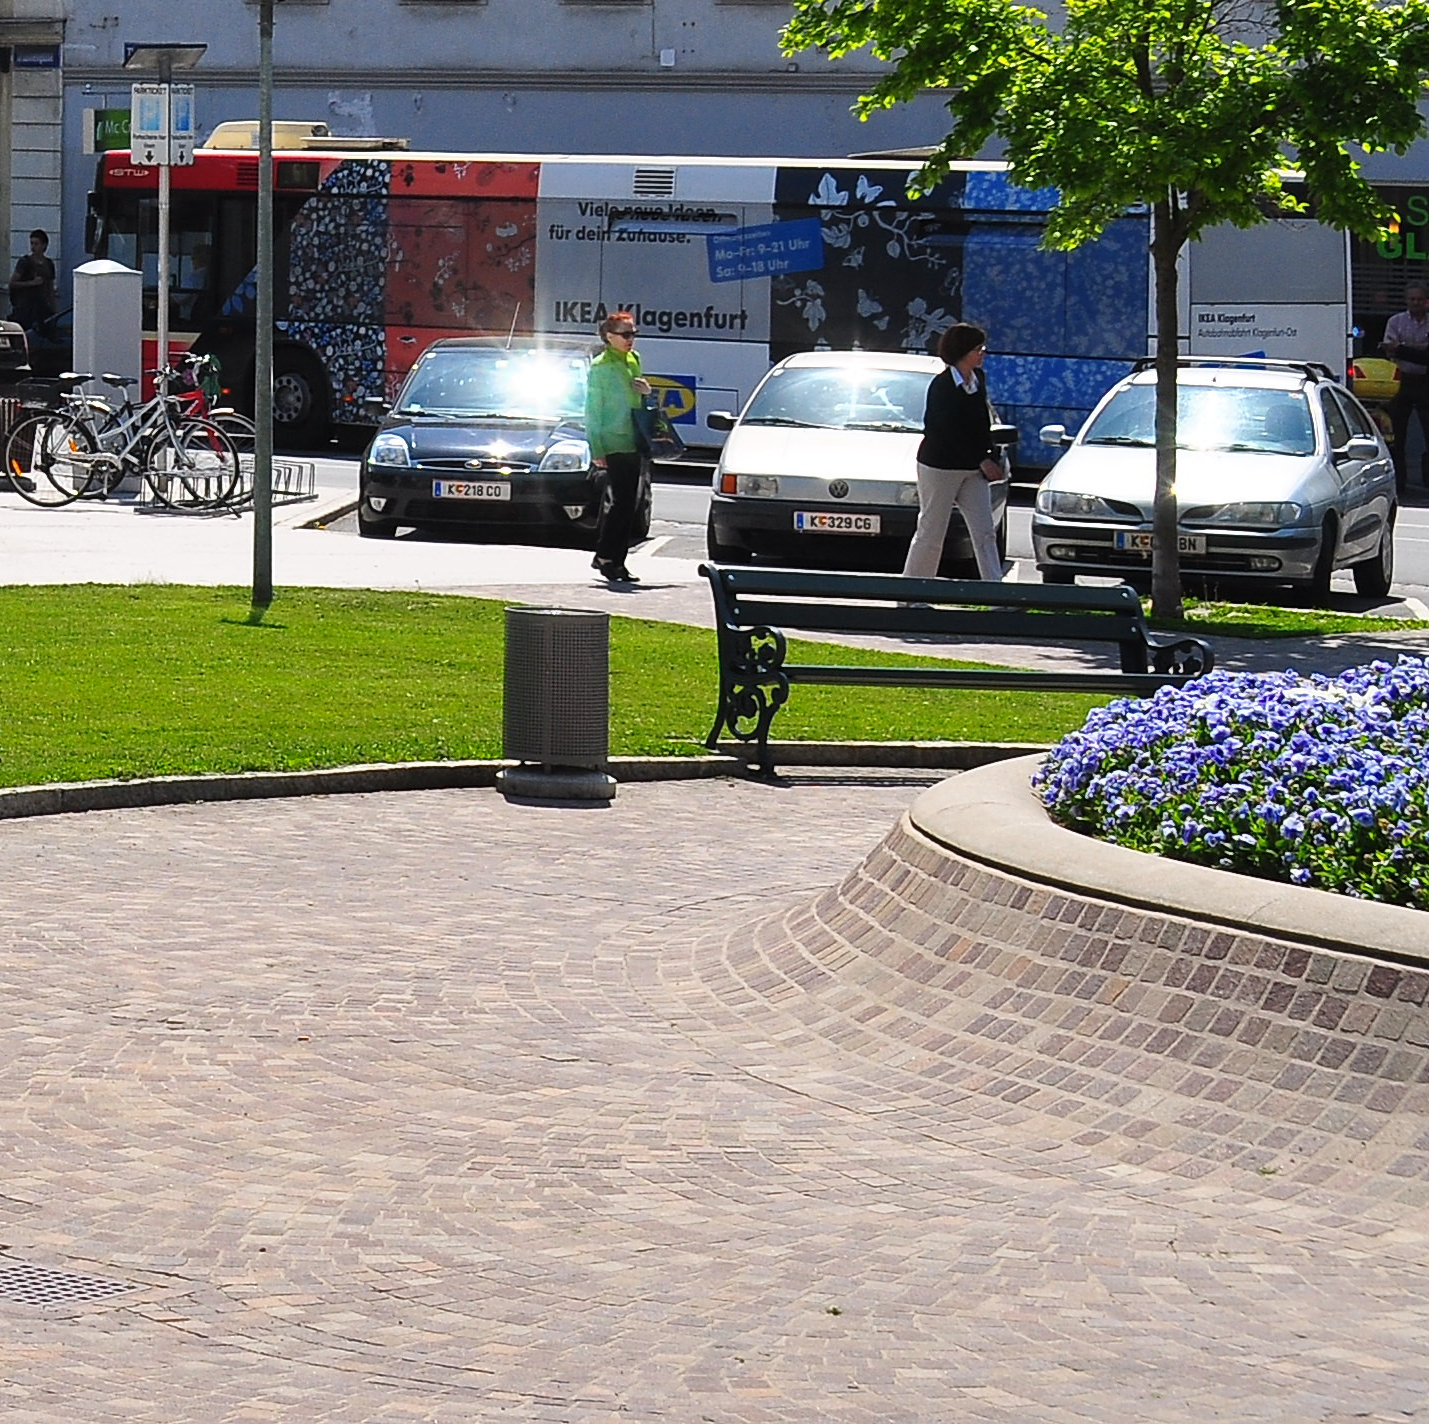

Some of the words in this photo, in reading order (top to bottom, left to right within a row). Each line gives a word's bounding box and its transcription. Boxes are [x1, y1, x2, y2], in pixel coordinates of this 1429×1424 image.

[549, 224, 572, 240] für
[576, 226, 611, 242] dein
[788, 239, 810, 251] Uhr
[716, 266, 735, 278] Sa:
[767, 259, 790, 271] Uhr
[554, 301, 608, 324] IKEA
[617, 303, 748, 333] Klagenfurt
[1198, 313, 1215, 323] IKEA
